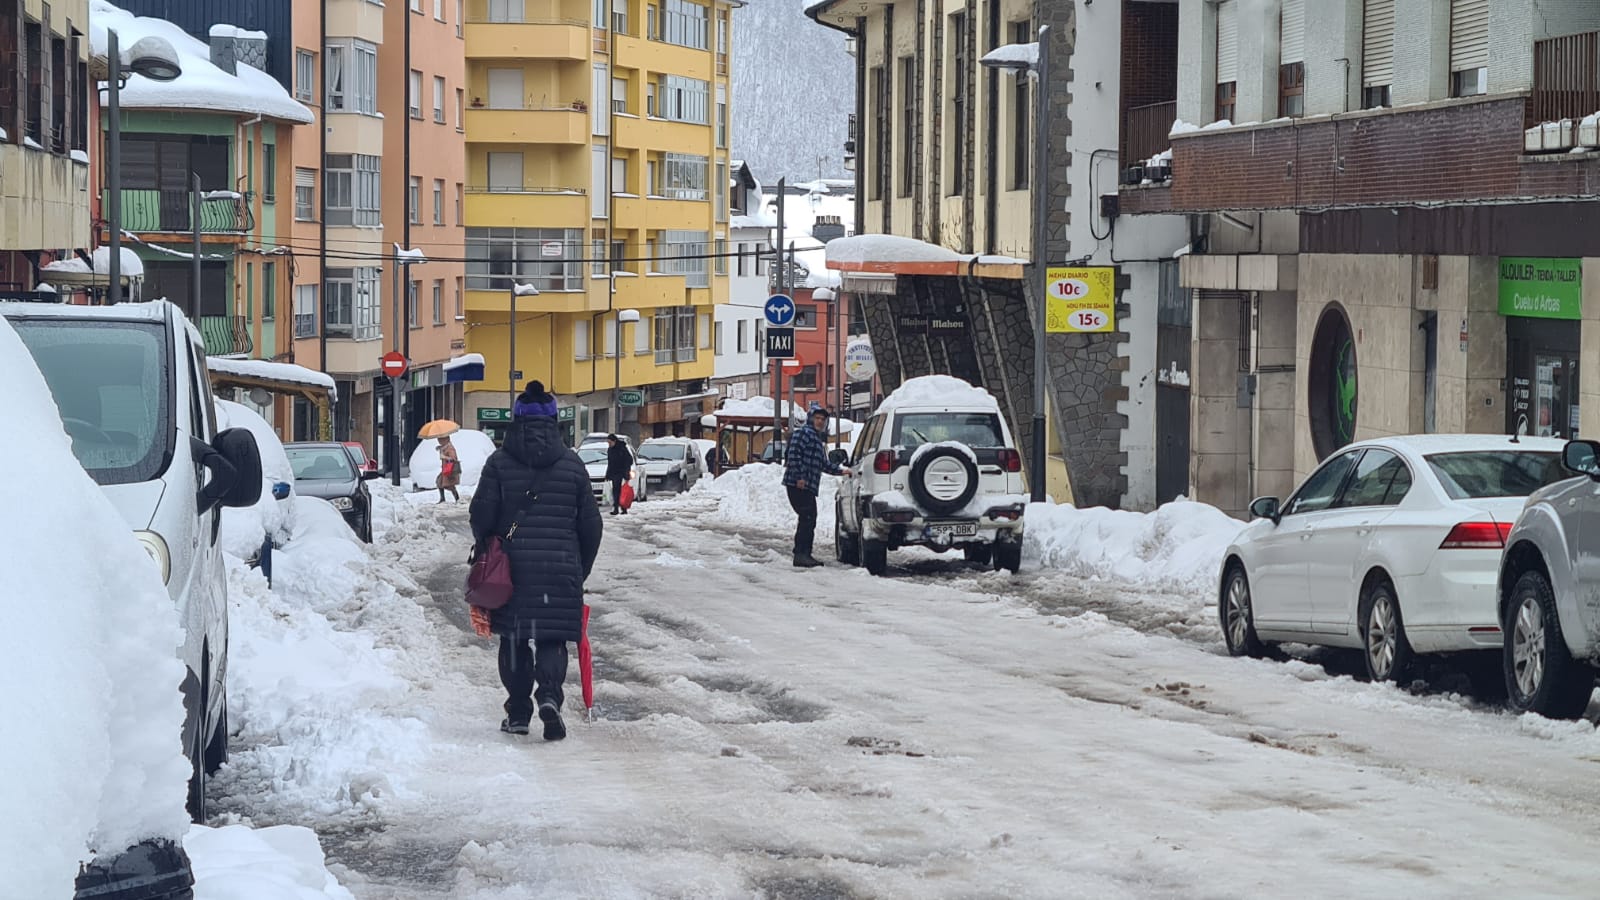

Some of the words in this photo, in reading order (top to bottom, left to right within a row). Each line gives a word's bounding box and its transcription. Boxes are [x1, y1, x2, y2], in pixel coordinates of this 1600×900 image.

[1501, 263, 1534, 280] ALQUILER
[1557, 270, 1577, 282] TALLER
[932, 319, 964, 328] Mahou
[769, 335, 791, 350] TAXI
[956, 525, 972, 534] DBK
